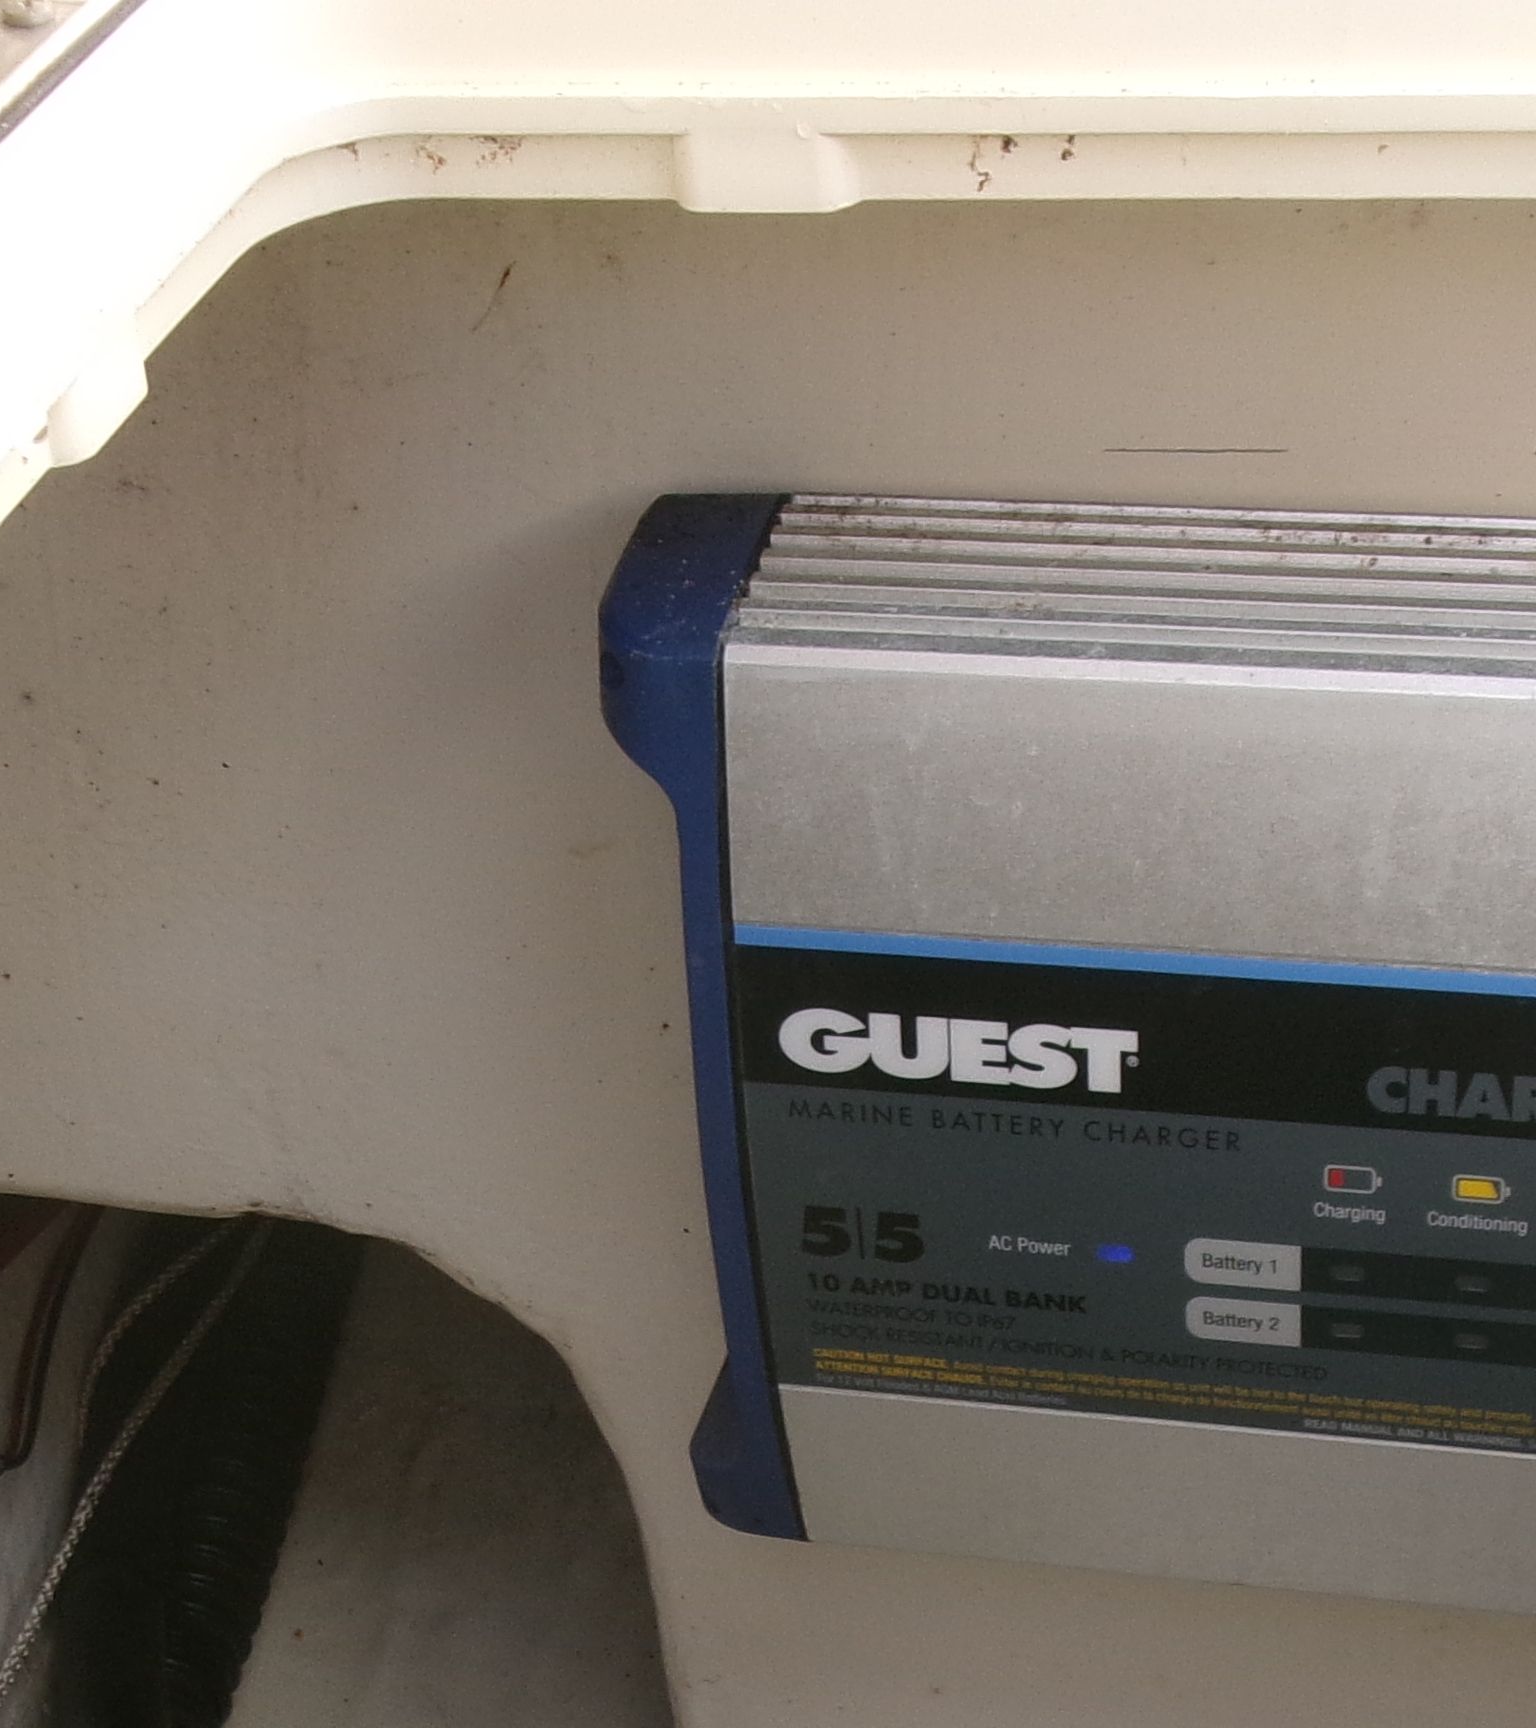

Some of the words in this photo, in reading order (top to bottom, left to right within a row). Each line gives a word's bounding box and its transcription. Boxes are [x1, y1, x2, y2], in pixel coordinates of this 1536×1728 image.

[779, 1007, 1138, 1094] GUEST
[788, 1099, 913, 1128] MARINE
[931, 1109, 1066, 1140] BATTERY
[1083, 1119, 1242, 1153] CHARGER
[1313, 1201, 1386, 1224] Charging
[1426, 1211, 1529, 1236] Conditioning
[989, 1234, 1013, 1253] AC
[1017, 1236, 1072, 1258] Power
[1201, 1252, 1264, 1275] Battery
[1269, 1257, 1279, 1275] 1
[808, 1272, 840, 1293] 10
[851, 1277, 911, 1297] AMP
[922, 1283, 997, 1306] DUAL
[1005, 1290, 1087, 1314] BANK
[809, 1299, 938, 1323] WATERPROOF
[945, 1310, 973, 1327] TO
[1202, 1310, 1263, 1332] Battery
[1269, 1317, 1280, 1332] 2
[811, 1320, 878, 1340] SHOCK
[885, 1326, 984, 1350] RESISTANT
[1122, 1348, 1210, 1371] POLARITY
[1215, 1356, 1329, 1381] PROTECTED
